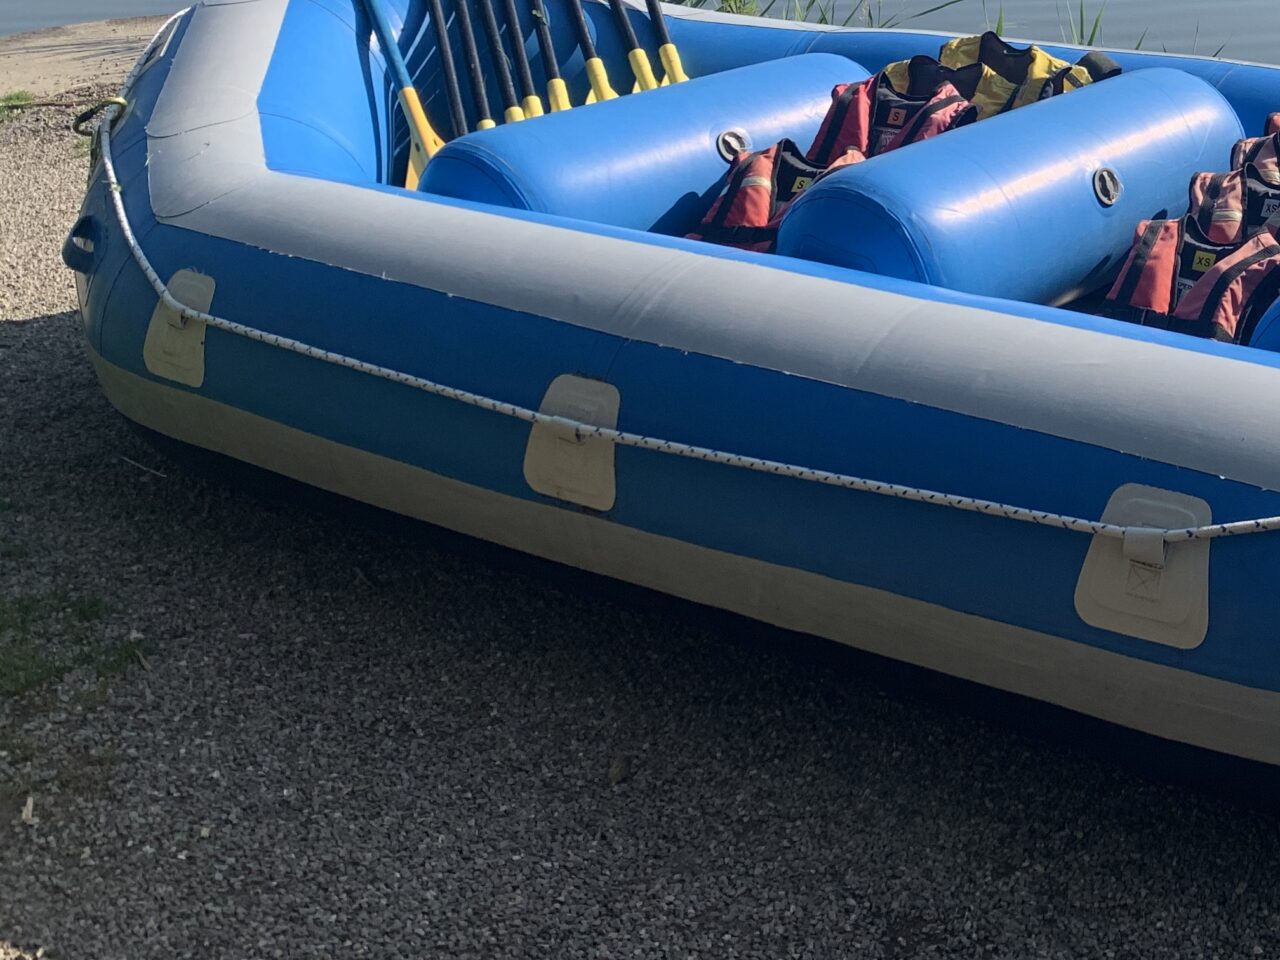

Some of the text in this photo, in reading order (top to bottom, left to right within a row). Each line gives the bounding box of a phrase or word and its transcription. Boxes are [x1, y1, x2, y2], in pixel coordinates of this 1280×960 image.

[892, 111, 900, 122] S
[797, 180, 805, 189] S
[1196, 256, 1211, 267] XS
